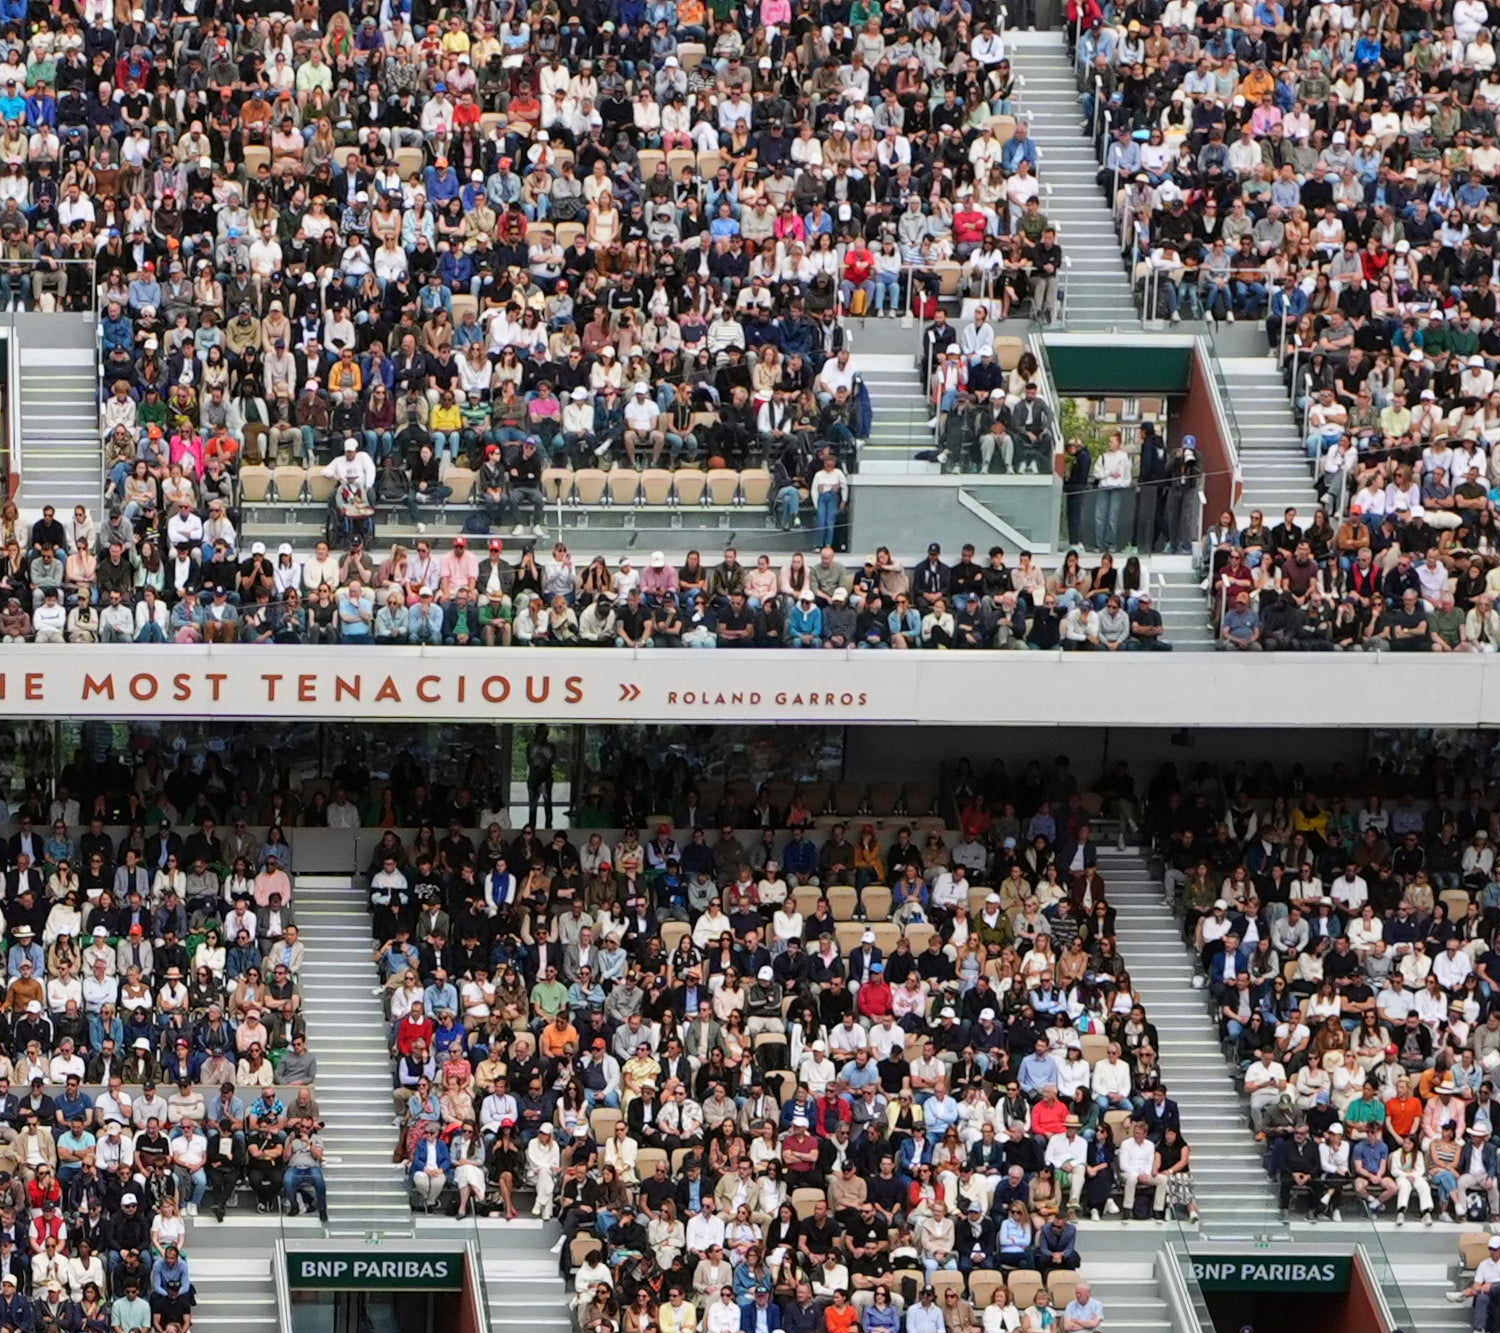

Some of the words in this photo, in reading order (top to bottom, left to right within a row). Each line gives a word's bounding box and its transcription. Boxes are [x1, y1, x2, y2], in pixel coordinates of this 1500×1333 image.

[82, 673, 227, 702] MOST
[262, 673, 585, 704] TENACIOUS
[667, 691, 765, 706] ROLAND
[775, 691, 869, 706] GARROS
[301, 1261, 348, 1277] BNP
[353, 1261, 448, 1277] PARIBAS
[1241, 1264, 1335, 1281] PARIBAS
